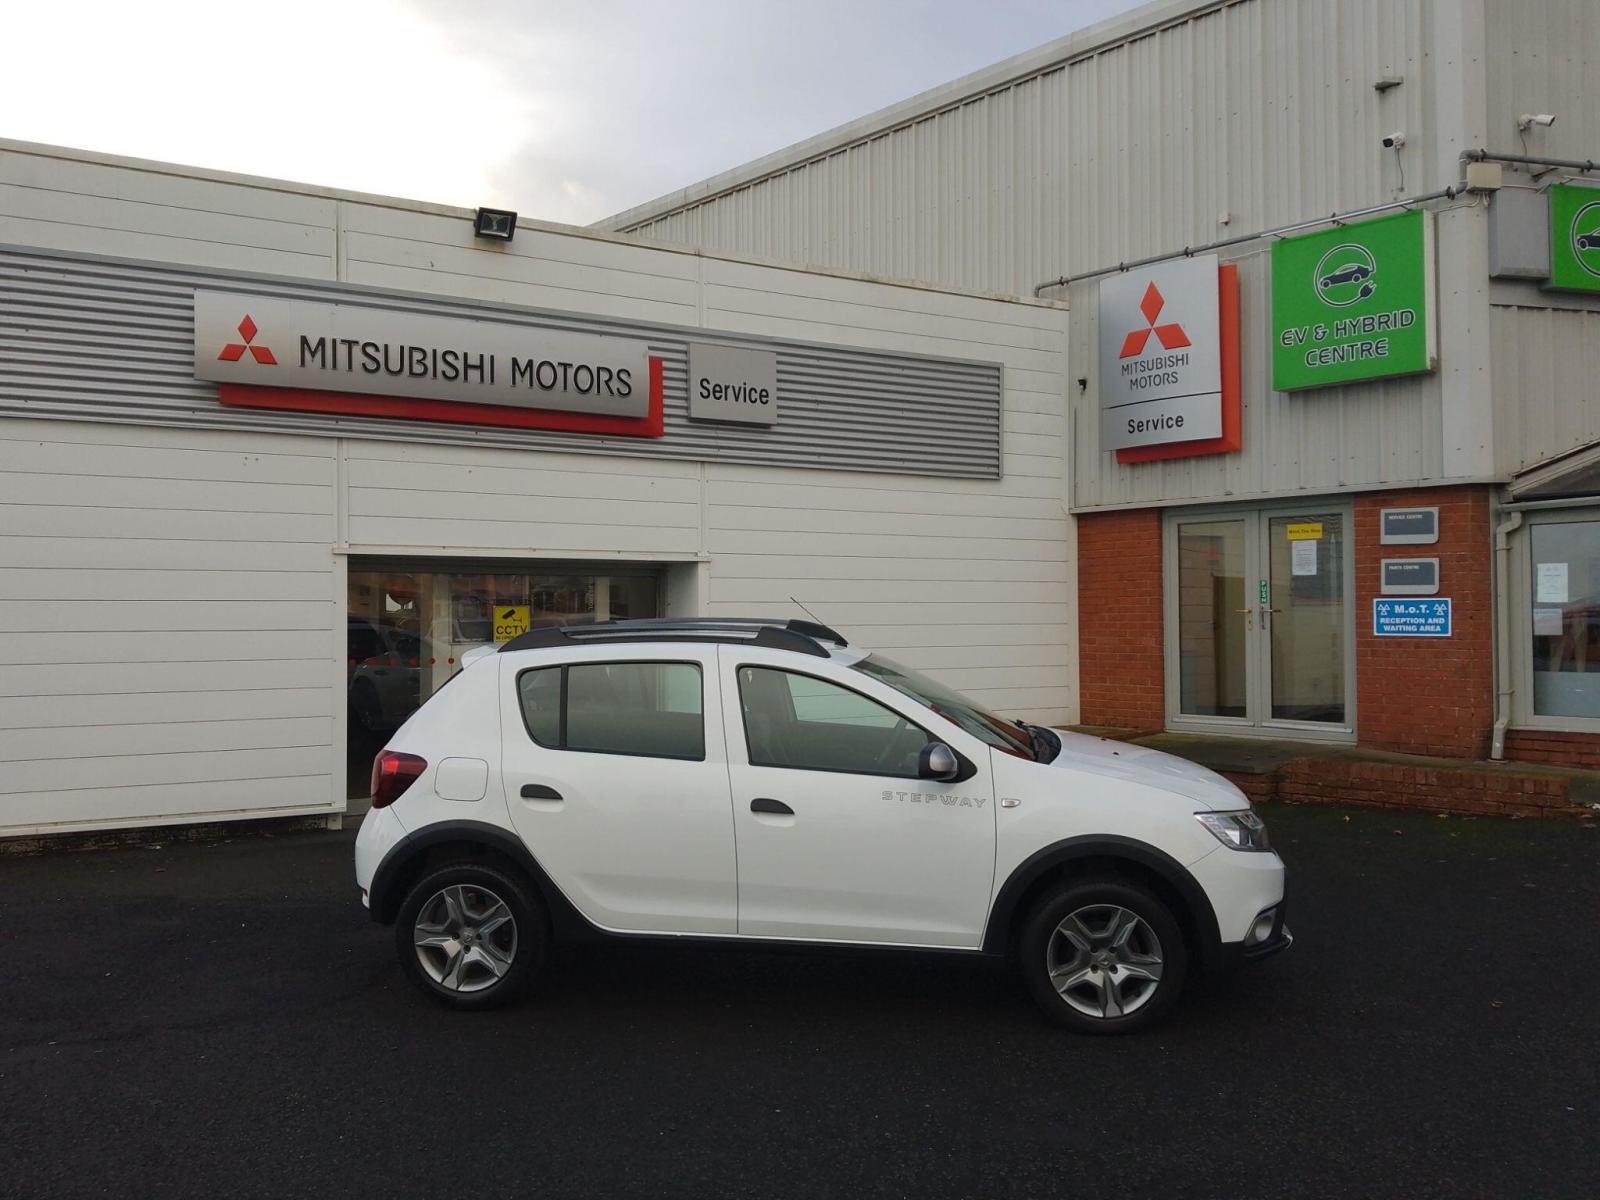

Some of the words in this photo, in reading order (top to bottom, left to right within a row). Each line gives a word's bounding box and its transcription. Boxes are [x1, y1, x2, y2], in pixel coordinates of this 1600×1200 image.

[1280, 327, 1308, 347] EV
[1313, 323, 1329, 342] &
[1334, 308, 1416, 338] HYBRID
[1304, 338, 1389, 367] CENTRE
[299, 335, 496, 385] MITSUBISHI
[510, 356, 633, 398] MOTORS
[1121, 353, 1189, 376] MITSUBISHI
[700, 377, 770, 405] Service
[1130, 371, 1179, 390] MOTORS
[1127, 414, 1184, 434] Service
[1394, 604, 1430, 614] M.o.T.
[496, 625, 528, 635] CCTV
[881, 790, 986, 808] STEPWAY
